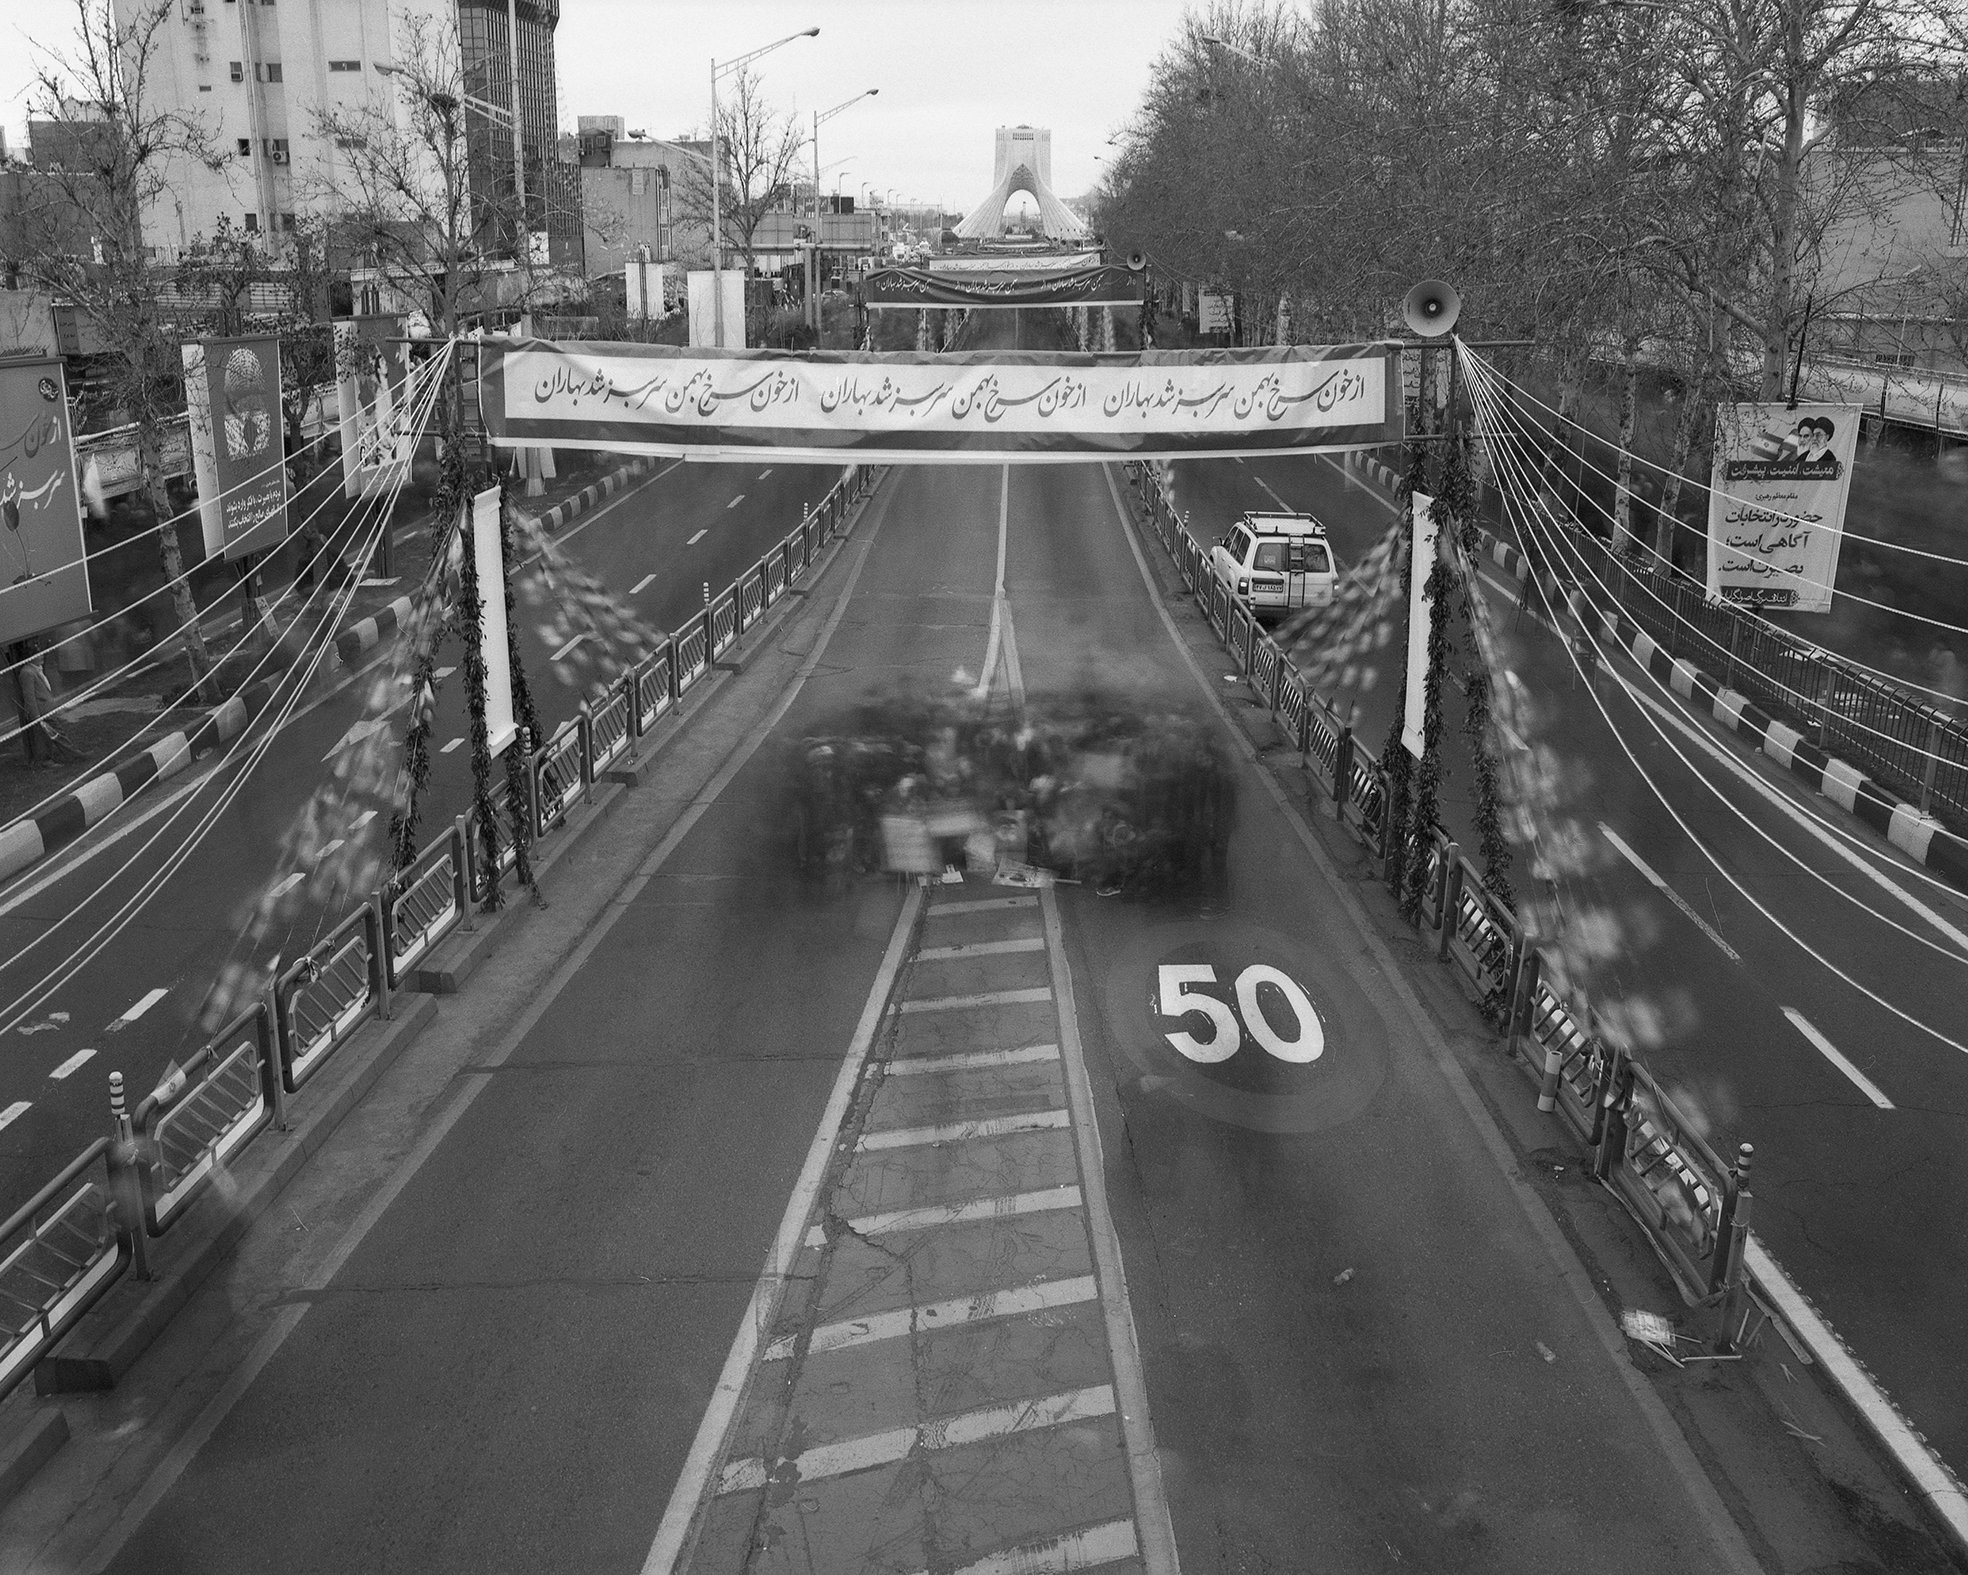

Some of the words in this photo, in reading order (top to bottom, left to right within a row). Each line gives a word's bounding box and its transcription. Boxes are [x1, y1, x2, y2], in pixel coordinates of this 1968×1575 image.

[535, 365, 585, 407] بهاران
[583, 368, 605, 396] شد
[603, 376, 667, 410] سرسبز
[665, 367, 708, 414] بهمن
[697, 371, 774, 417] سرخ
[750, 370, 788, 413] خون
[783, 377, 799, 404] از
[820, 377, 872, 416] بهاران
[868, 376, 892, 406] شد
[888, 381, 954, 418] سرسبز
[951, 373, 994, 420] بهمن
[984, 376, 1061, 423] سرخ
[1038, 376, 1075, 418] خون
[1070, 382, 1086, 409] از
[1103, 380, 1155, 419] بهاران
[1151, 378, 1175, 408] شد
[1171, 381, 1235, 419] سرسبز
[1233, 372, 1275, 420] بهمن
[1267, 369, 1340, 422] سرخ
[1317, 368, 1353, 412] خون
[1349, 374, 1365, 402] از
[49, 415, 62, 445] از
[16, 469, 66, 510] سرسبز
[1725, 504, 1778, 527] انتخابات
[1759, 530, 1813, 554] آگاهی
[1718, 559, 1755, 573] است.
[1158, 964, 1325, 1064] 50
